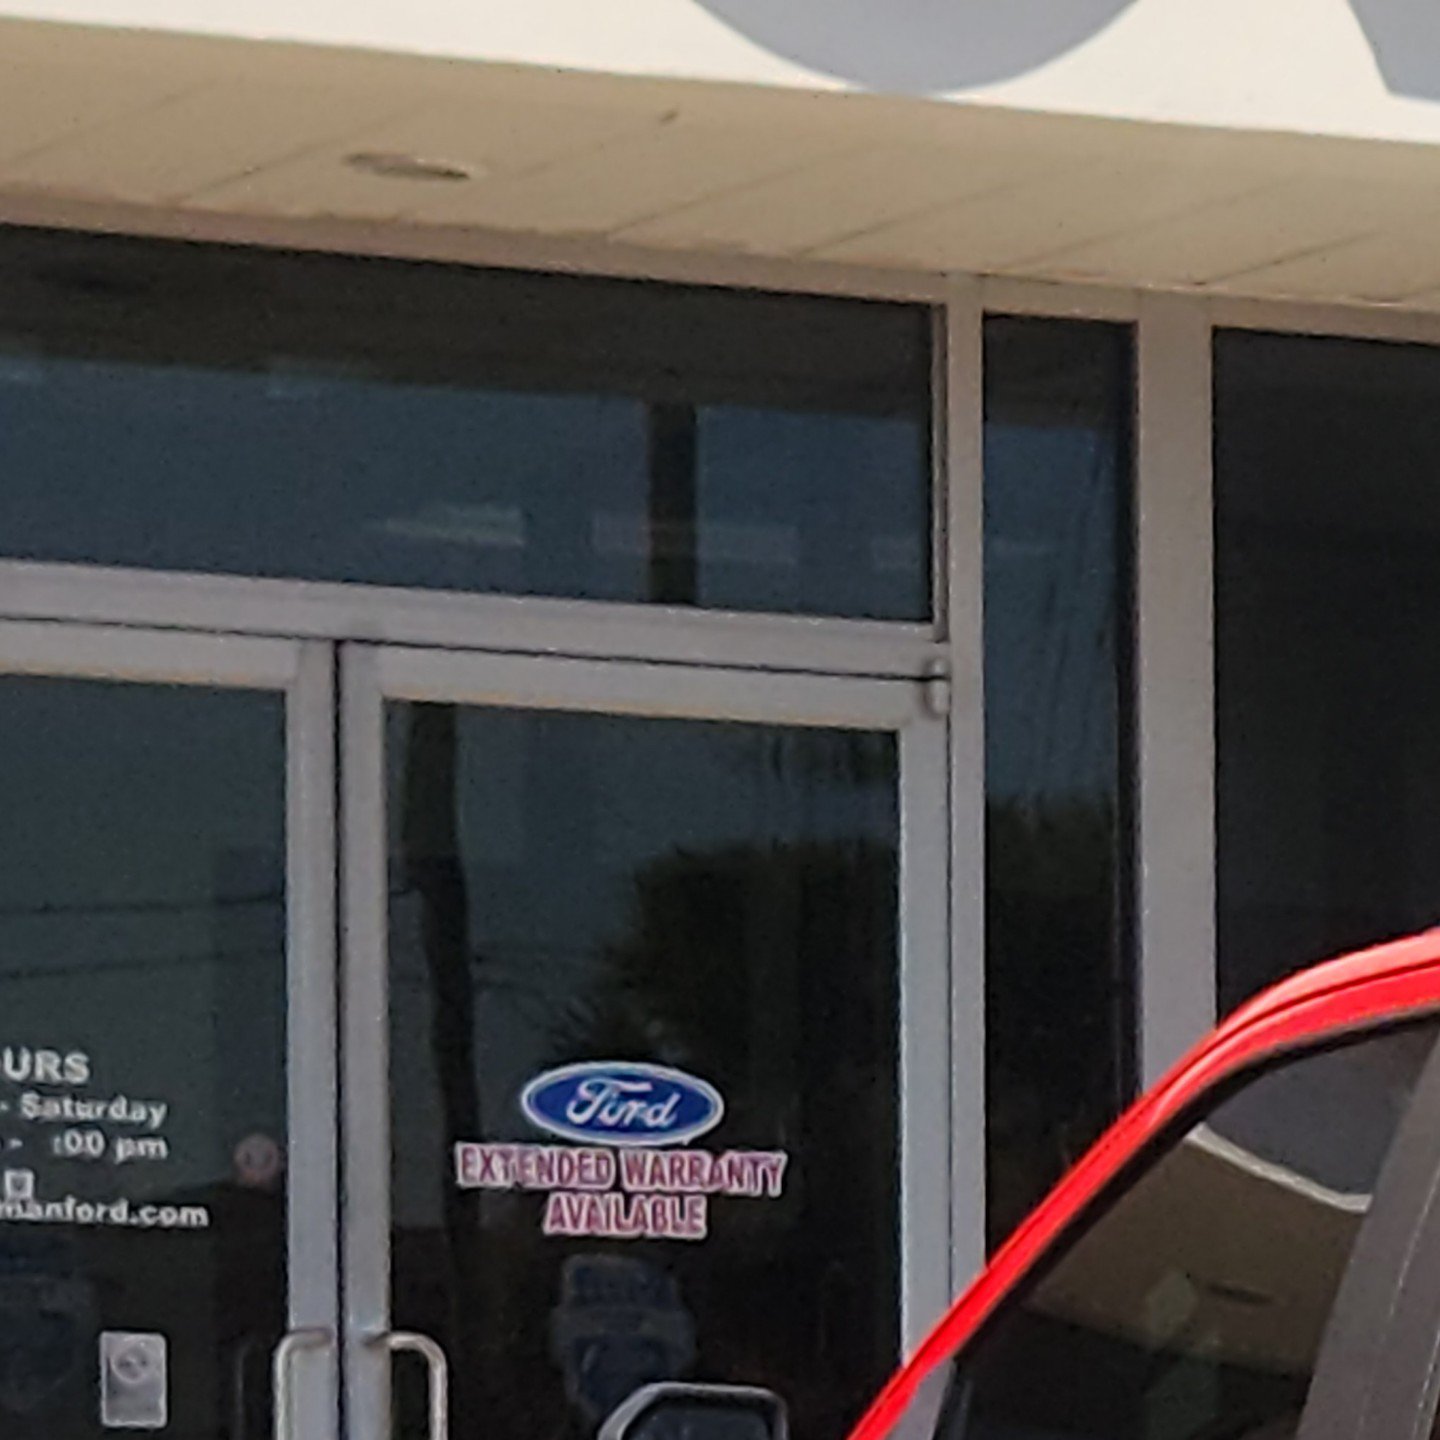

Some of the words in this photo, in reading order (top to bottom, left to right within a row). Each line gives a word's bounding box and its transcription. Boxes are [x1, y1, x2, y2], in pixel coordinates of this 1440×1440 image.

[21, 1091, 168, 1130] Saturday
[565, 1070, 681, 1128] Ford
[114, 1136, 169, 1165] pm
[456, 1142, 617, 1189] EXTENDED
[619, 1147, 788, 1197] WARRANTY
[543, 1192, 708, 1239] AVAILABLE
